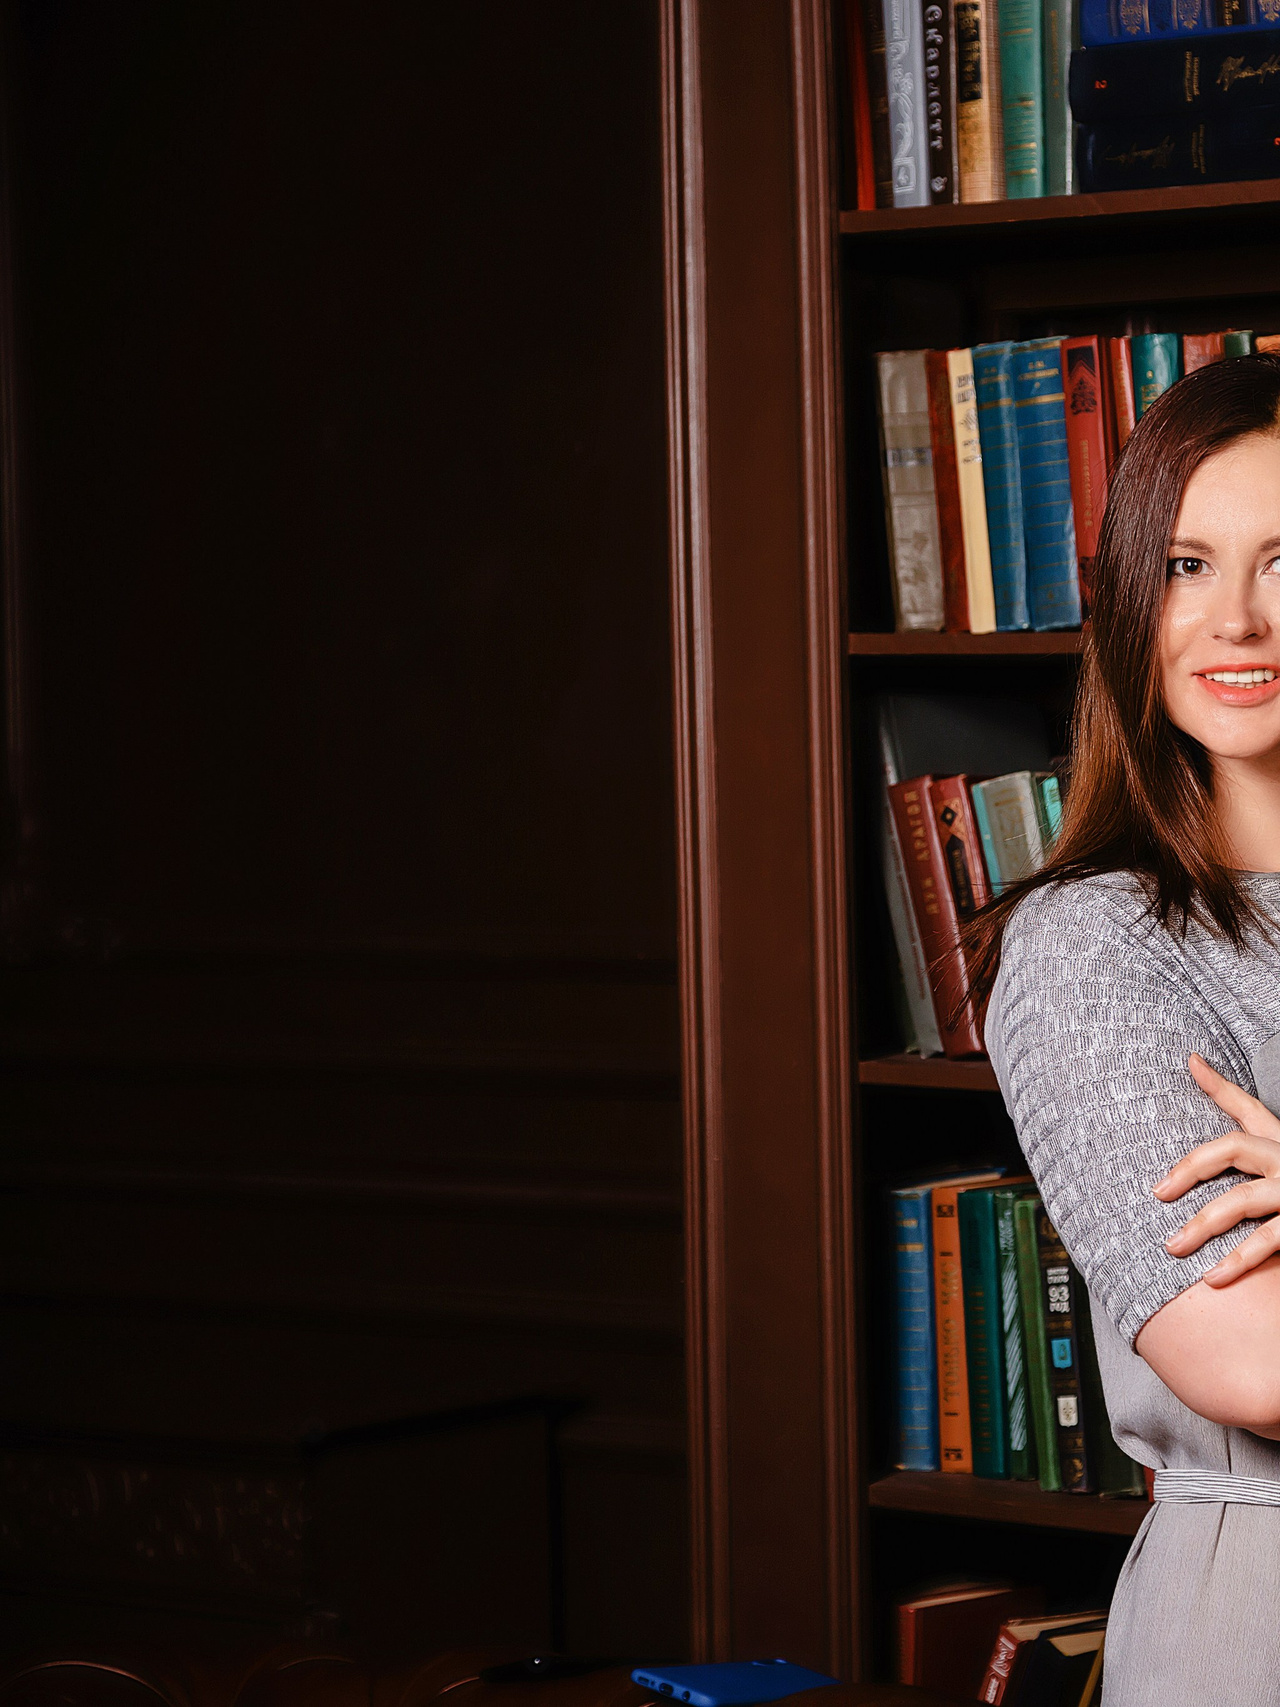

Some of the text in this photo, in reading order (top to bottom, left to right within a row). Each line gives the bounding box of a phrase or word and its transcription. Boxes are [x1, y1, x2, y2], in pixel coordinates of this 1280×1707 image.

[1095, 79, 1107, 90] 2
[1048, 1284, 1070, 1302] 93
[1049, 1301, 1071, 1313] ГОД
